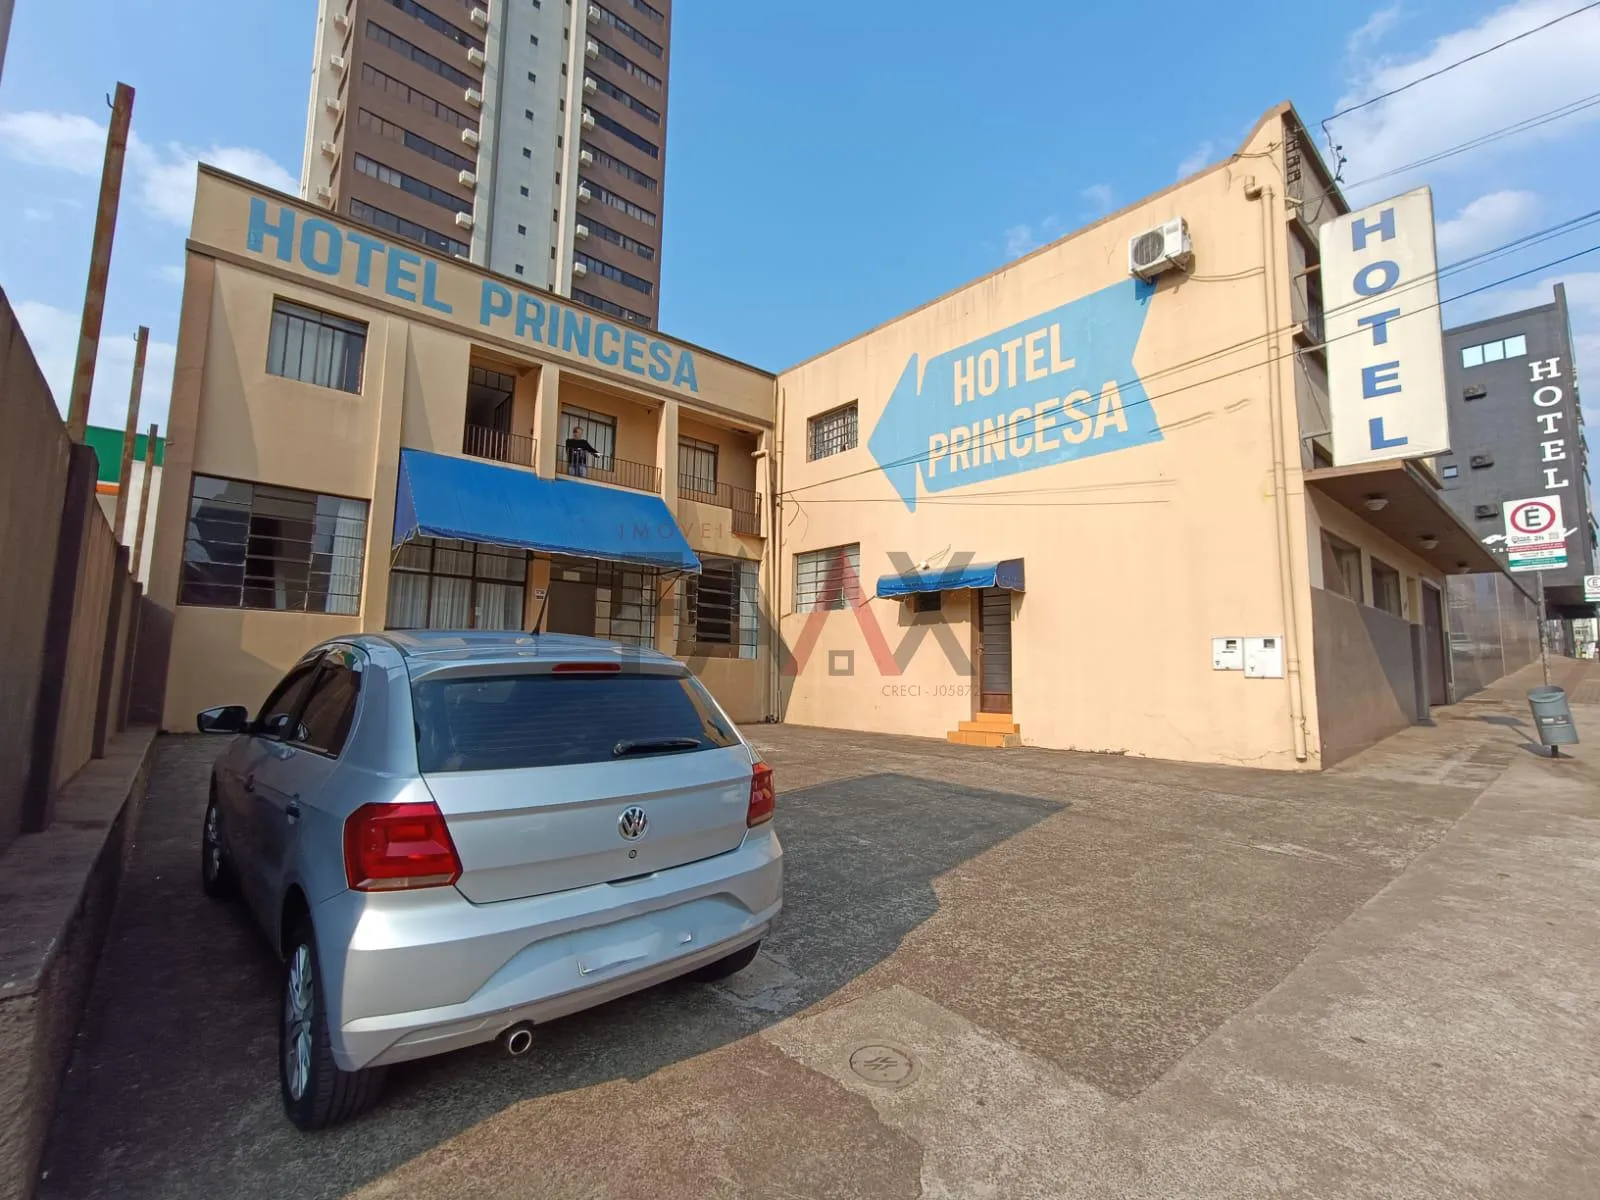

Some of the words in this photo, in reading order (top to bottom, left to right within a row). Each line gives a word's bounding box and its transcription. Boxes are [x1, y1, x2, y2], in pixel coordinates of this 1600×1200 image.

[247, 197, 453, 314] HOTEL
[480, 279, 700, 392] PRINCESA
[1351, 207, 1409, 450] HOTEL
[953, 323, 1076, 406] HOTEL
[928, 379, 1129, 478] PRINCESA
[1528, 357, 1569, 489] HOTEL
[1524, 508, 1542, 527] E
